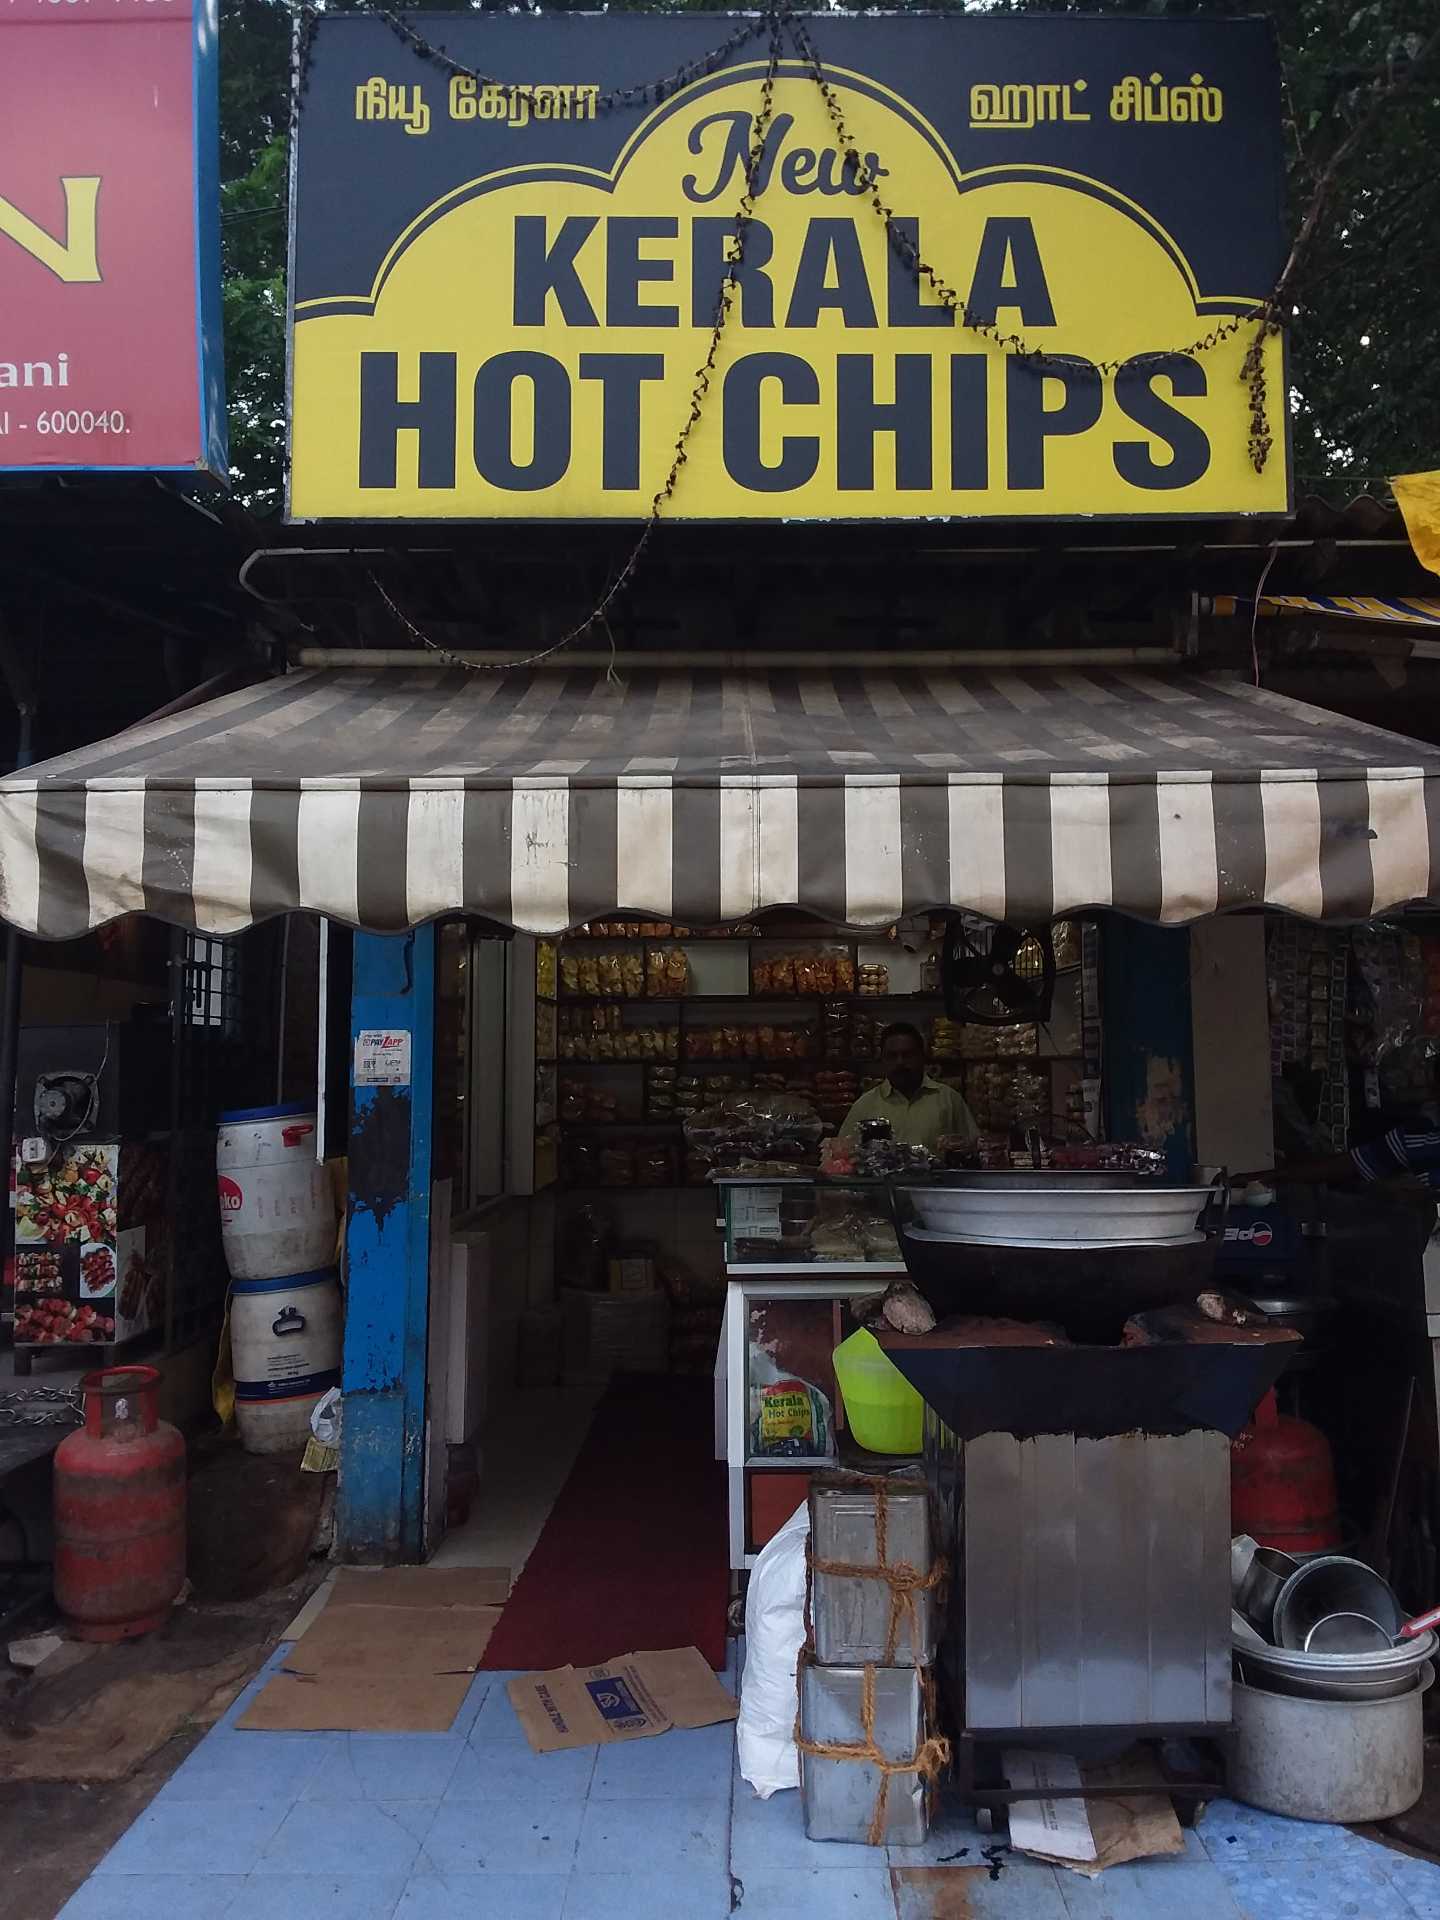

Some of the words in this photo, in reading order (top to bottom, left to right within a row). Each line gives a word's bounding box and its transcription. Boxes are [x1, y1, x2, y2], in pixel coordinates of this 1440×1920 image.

[355, 76, 431, 135] நியூ
[449, 75, 600, 127] கேரளா
[969, 79, 1091, 128] ஹாட்
[1109, 72, 1223, 123] சிப்ஸ்
[682, 110, 890, 203] New
[513, 215, 1057, 328] KERALA
[36, 410, 131, 435] 600040.
[358, 350, 665, 491] HOT
[722, 351, 1212, 492] CHIPS
